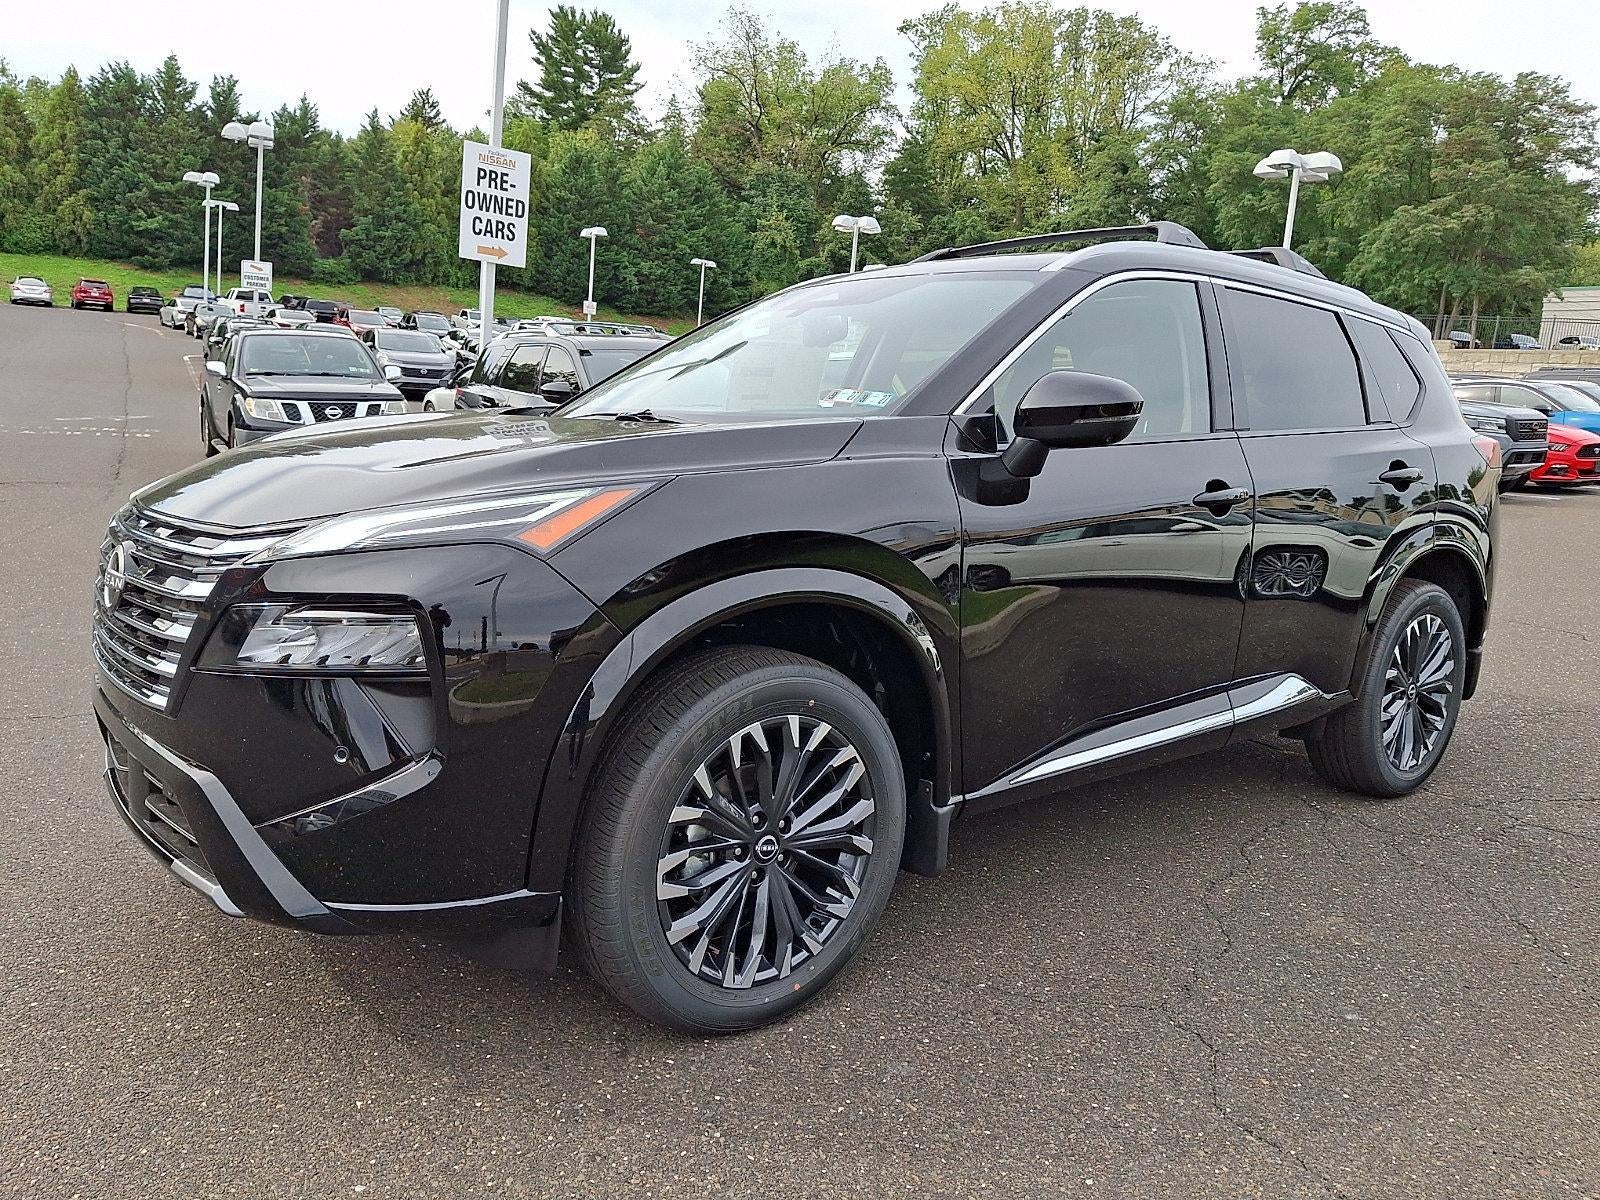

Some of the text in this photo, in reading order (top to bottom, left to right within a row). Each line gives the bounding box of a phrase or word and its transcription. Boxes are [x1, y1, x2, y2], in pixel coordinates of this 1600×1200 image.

[478, 153, 516, 168] NISSAN
[476, 167, 517, 192] PRE-
[464, 189, 526, 219] OWNED
[472, 216, 516, 241] CARS
[104, 572, 124, 589] SAN
